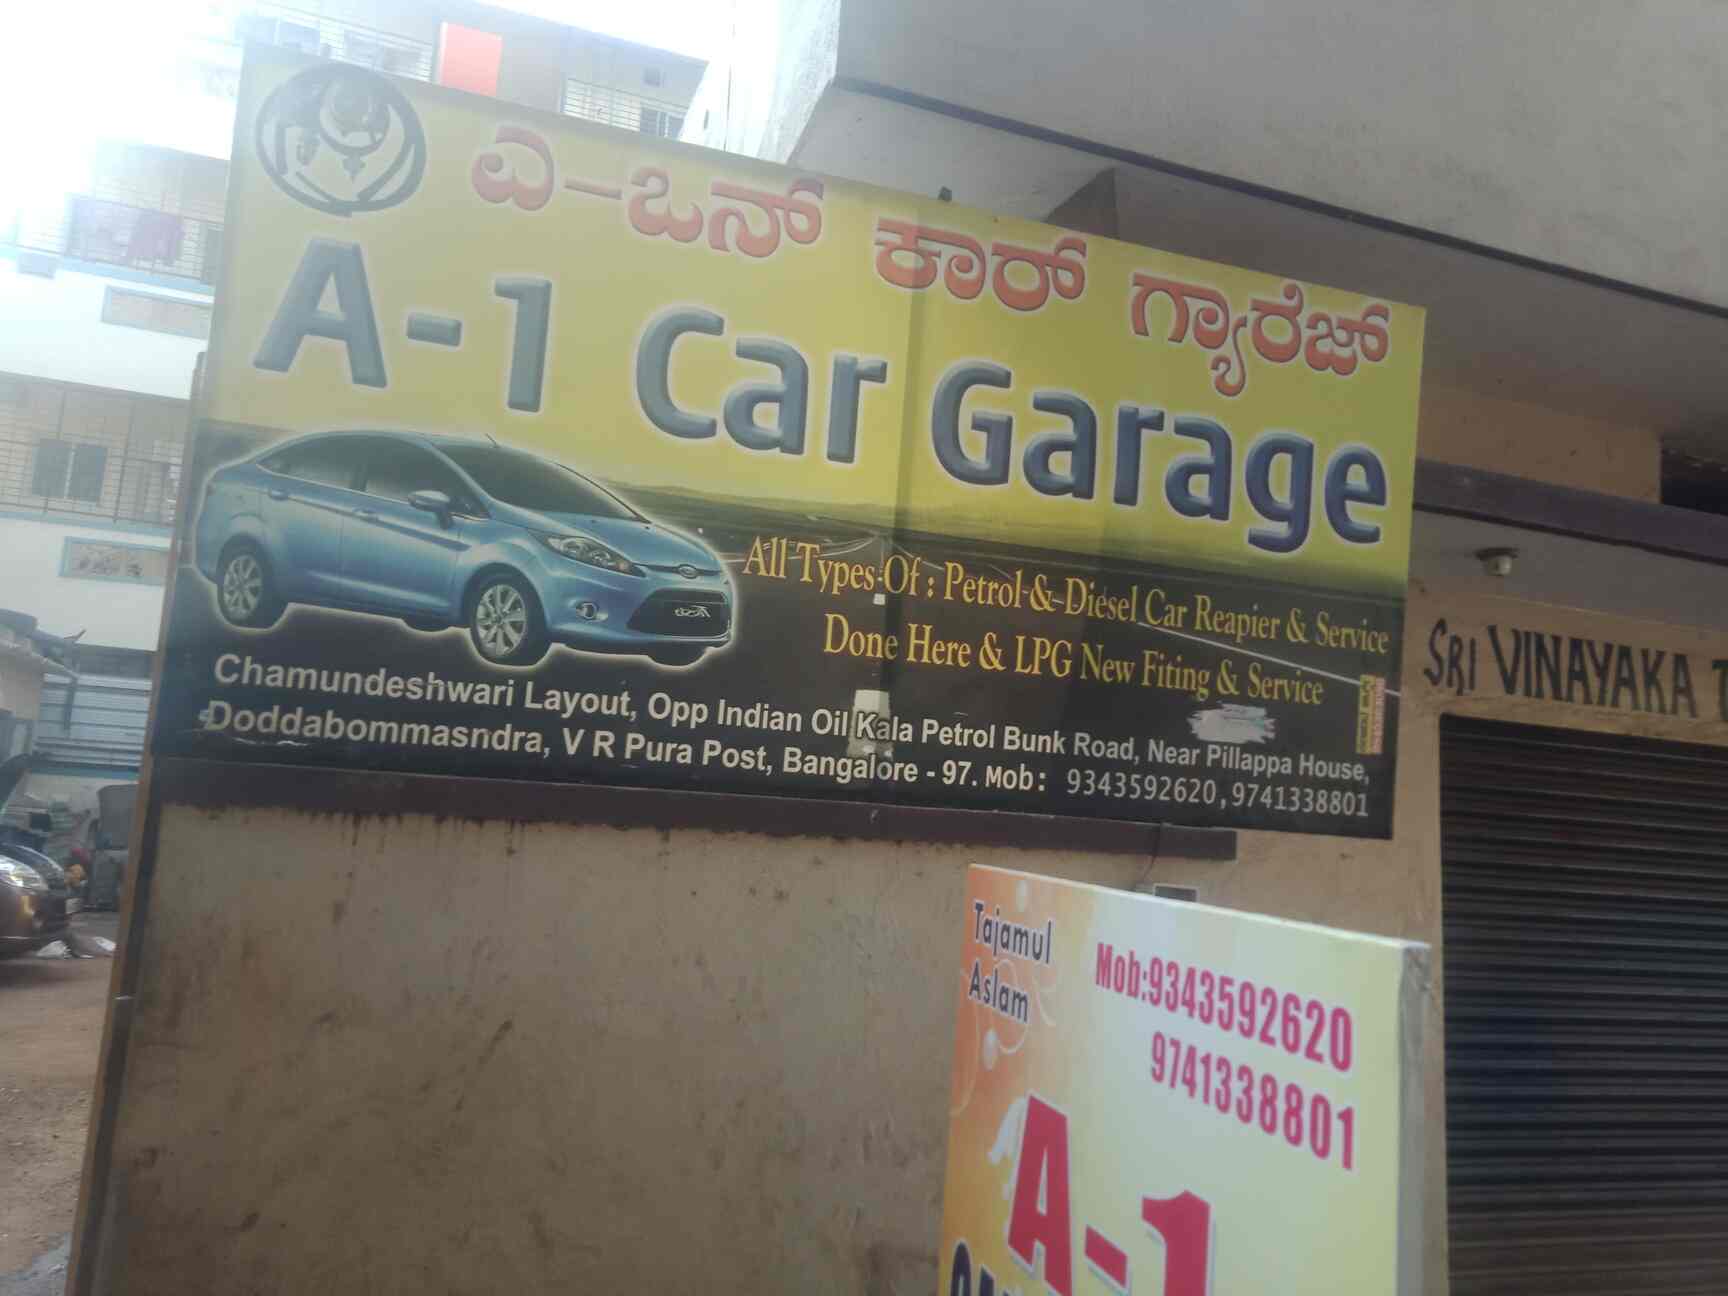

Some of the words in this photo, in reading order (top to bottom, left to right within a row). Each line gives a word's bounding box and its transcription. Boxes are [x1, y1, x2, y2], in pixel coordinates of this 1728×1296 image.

[875, 218, 1087, 311] ಕಾರ್
[252, 237, 552, 412] A-1
[635, 306, 888, 463] Car
[931, 360, 1387, 553] Garage
[742, 536, 788, 578] All
[796, 542, 875, 594] Types
[884, 555, 921, 596] Of
[944, 560, 1022, 609] Petrol
[1030, 574, 1056, 612] &
[1065, 577, 1137, 622] Diesel
[1145, 589, 1188, 628] Car
[1195, 594, 1280, 643] Reapier
[1286, 607, 1309, 643] &
[1316, 611, 1389, 654] Service
[823, 613, 899, 660] Done
[907, 623, 971, 668] Here
[979, 632, 1006, 671] &
[1016, 635, 1072, 677] LPG
[1080, 643, 1135, 683] New
[1142, 650, 1211, 700] Fiting
[1216, 659, 1239, 696] &
[1248, 662, 1324, 705] Service
[1424, 618, 1476, 696] SRI
[1487, 625, 1698, 718] VINAYAKA
[204, 700, 551, 757] Doddabommasndra,
[563, 728, 584, 755] V
[592, 730, 616, 758] R
[624, 733, 692, 764] Pura
[702, 739, 773, 775] Post,
[783, 747, 919, 784] Bangalore
[214, 653, 513, 706] Chamundeshwari
[524, 681, 637, 720] Layout,
[648, 692, 708, 728] Opp
[717, 699, 802, 732] Indian
[811, 708, 848, 737] Oil
[856, 712, 913, 742] Kala
[921, 718, 995, 749] Petrol
[1003, 726, 1065, 756] Bunk
[1074, 732, 1140, 765] Road,
[1148, 738, 1200, 766] Near
[1207, 744, 1292, 779] Pillappa
[1300, 753, 1371, 785] House,
[975, 902, 1051, 964] Tajamul
[969, 962, 1028, 1022] Aslam
[1151, 1032, 1356, 1170] 9741338801
[1008, 1094, 1212, 1296] A-1
